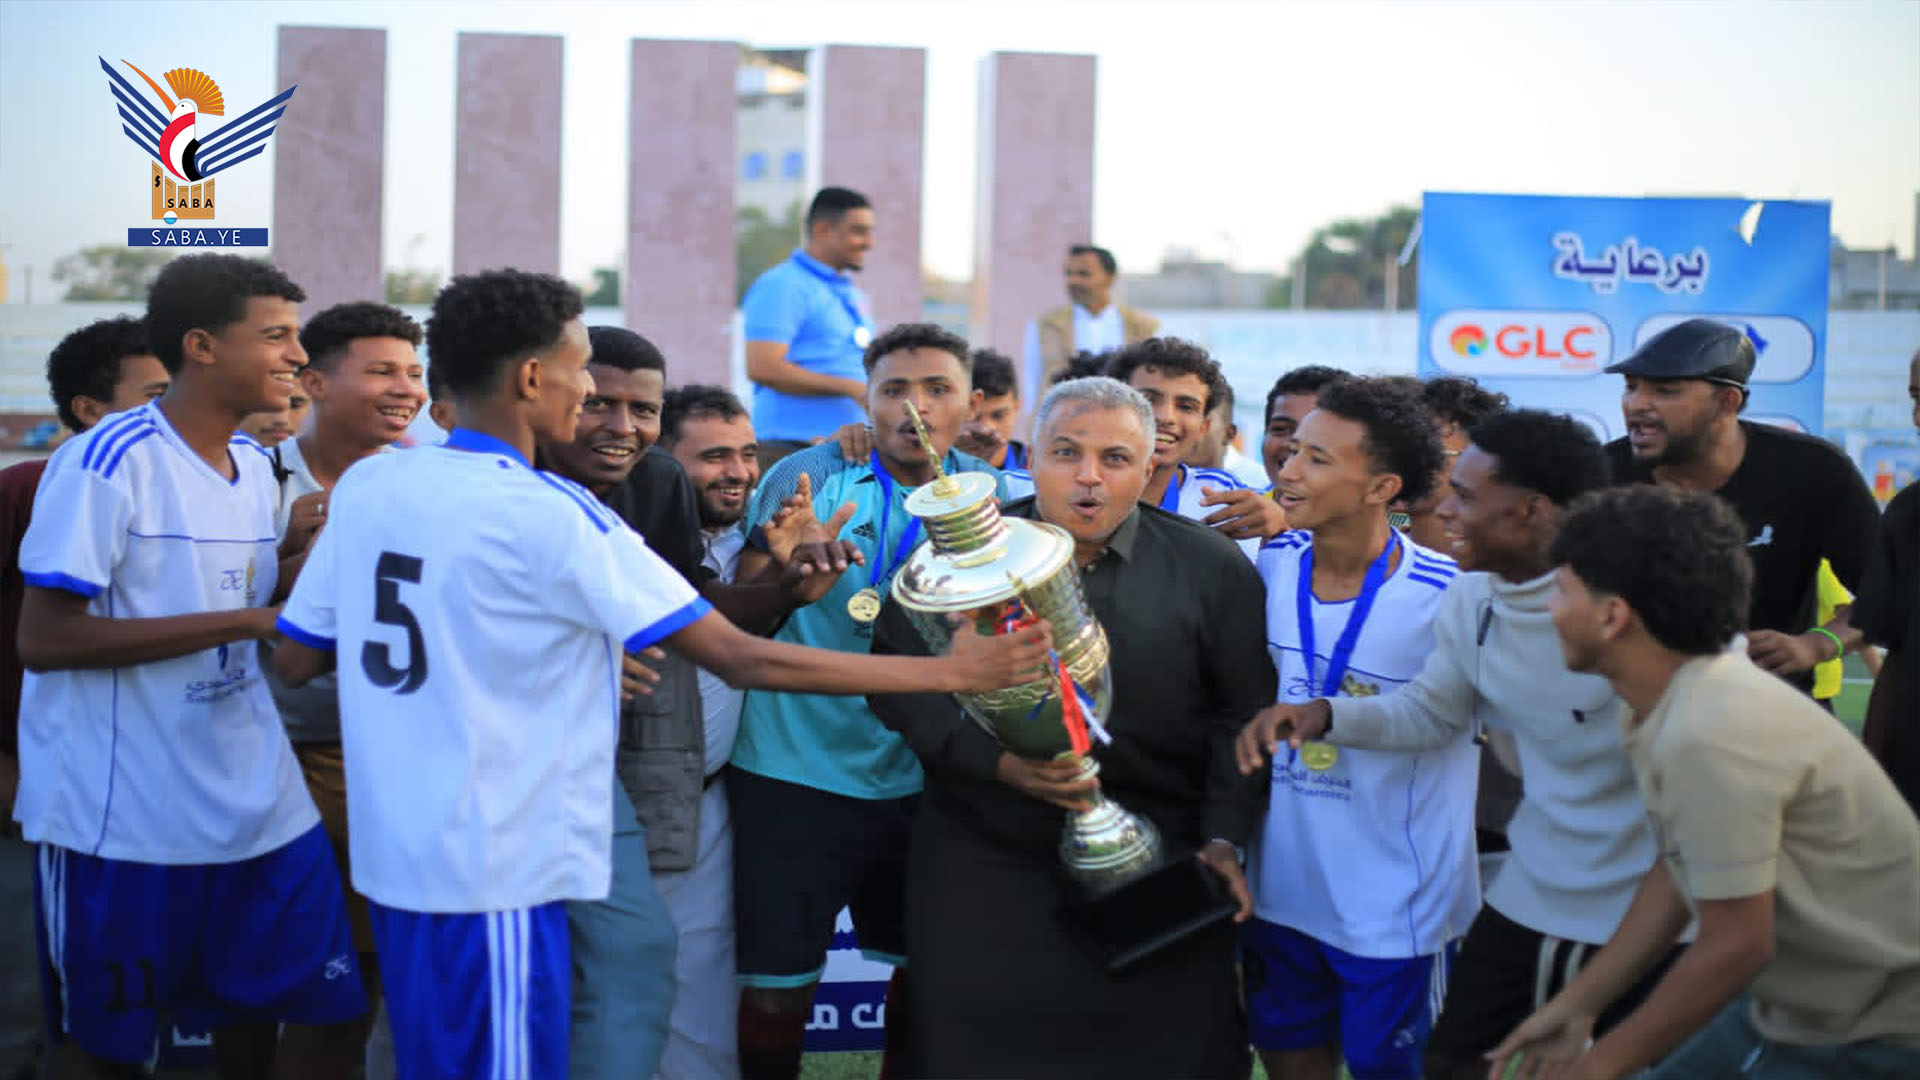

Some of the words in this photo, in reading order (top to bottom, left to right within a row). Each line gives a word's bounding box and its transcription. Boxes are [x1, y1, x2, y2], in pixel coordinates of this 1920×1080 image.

[1554, 233, 1708, 293] برعاية
[1495, 324, 1596, 359] GLC
[361, 550, 428, 694] 5
[105, 959, 158, 1014] 11
